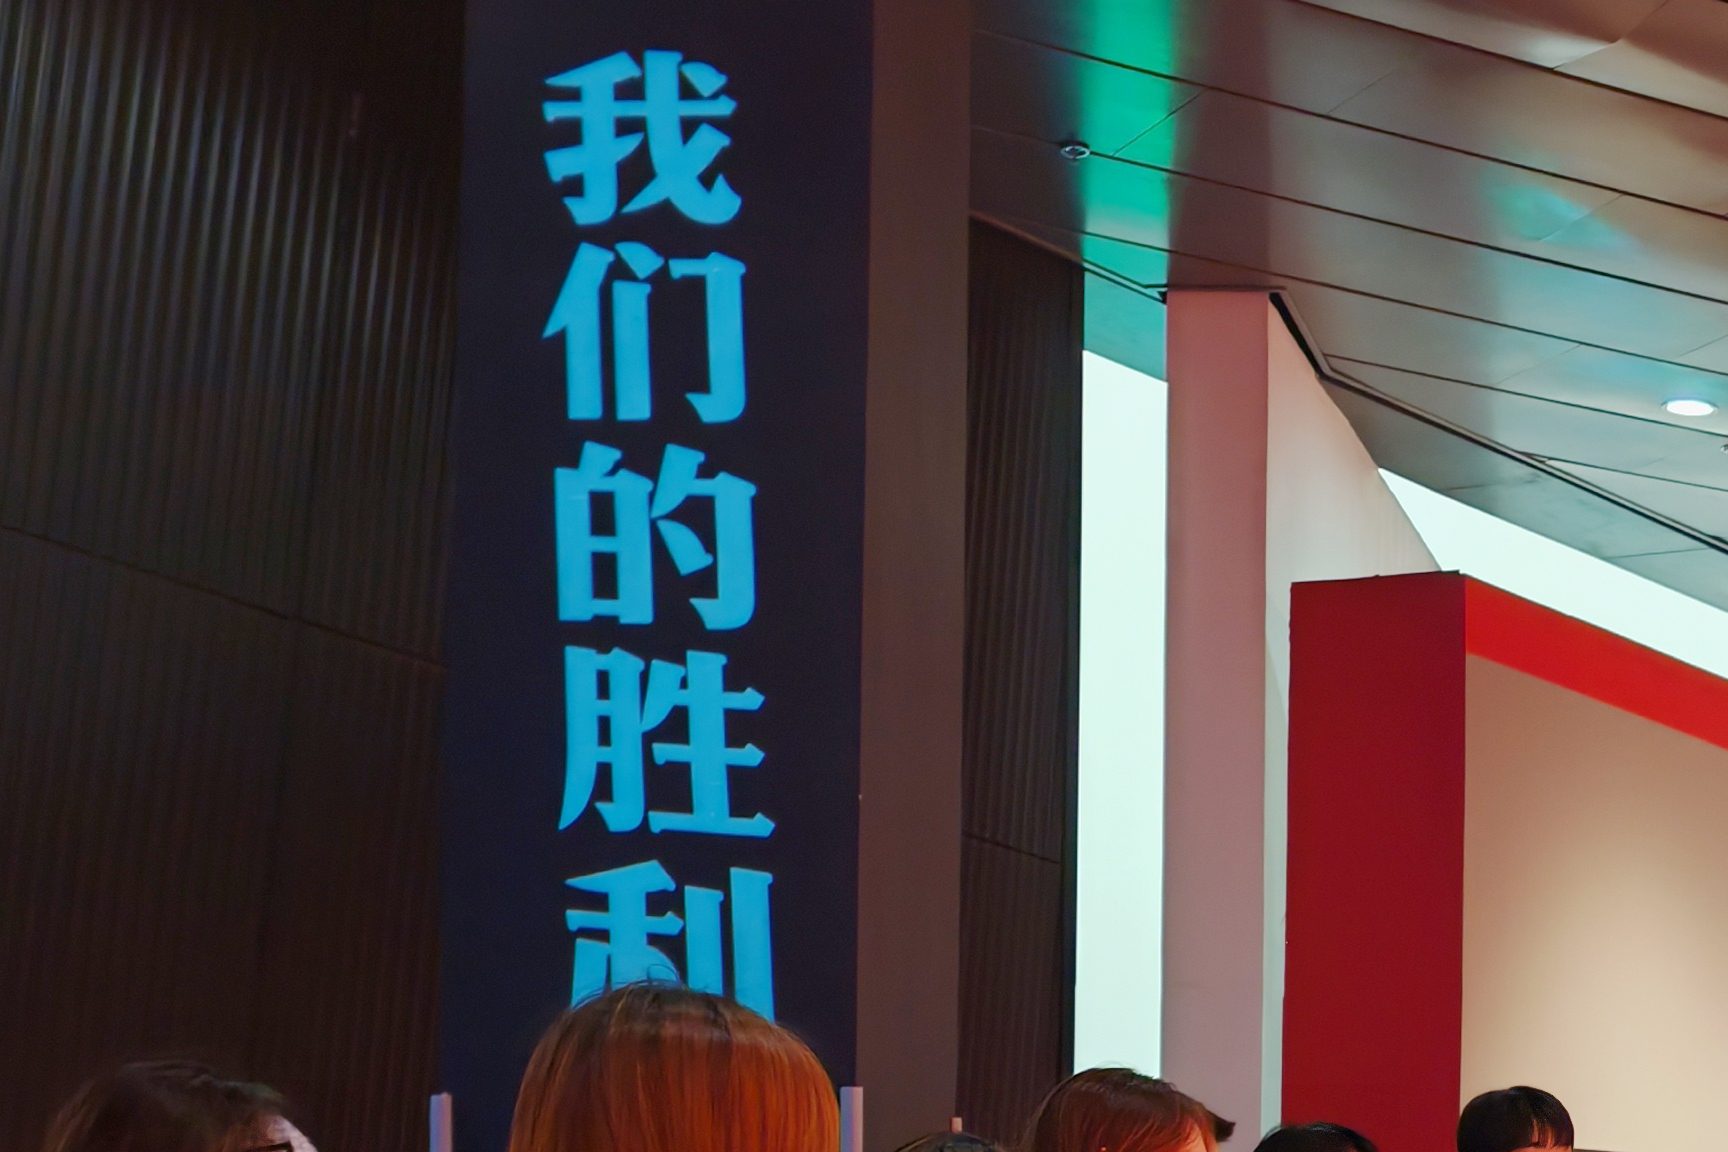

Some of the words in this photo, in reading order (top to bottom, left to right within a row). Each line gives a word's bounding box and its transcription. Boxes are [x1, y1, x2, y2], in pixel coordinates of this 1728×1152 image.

[542, 48, 776, 1011] 我们的胜利
